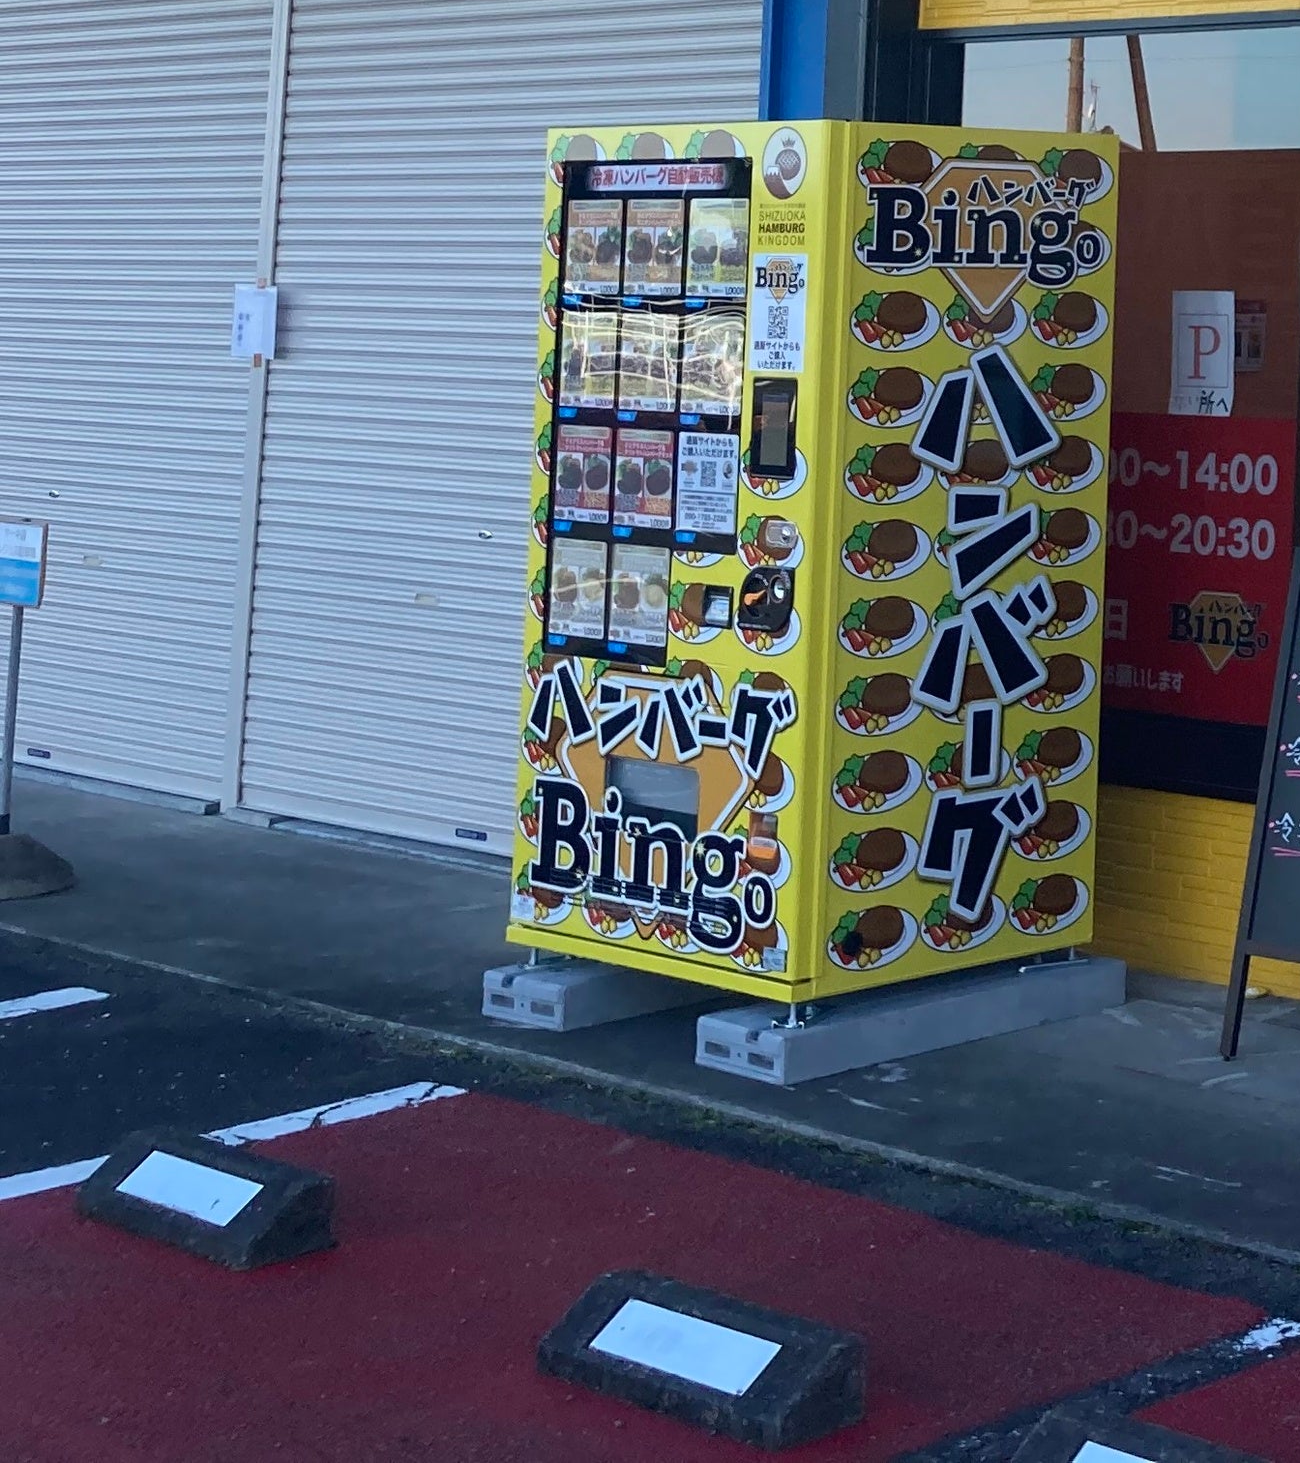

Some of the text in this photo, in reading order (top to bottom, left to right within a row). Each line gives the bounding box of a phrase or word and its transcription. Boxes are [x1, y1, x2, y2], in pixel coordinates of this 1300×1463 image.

[759, 211, 806, 222] SHIZUOKA
[966, 175, 1097, 211] ハンバーグ
[757, 235, 806, 246] KINGDOM
[758, 223, 806, 234] HAMBURG
[864, 183, 1105, 290] Bingo
[755, 266, 805, 295] Bingo
[1187, 325, 1222, 380] P
[911, 342, 1063, 926] ハンバーグ
[1168, 602, 1270, 659] Bingo
[527, 658, 797, 780] ハンバーグ
[528, 776, 777, 955] Bingo
